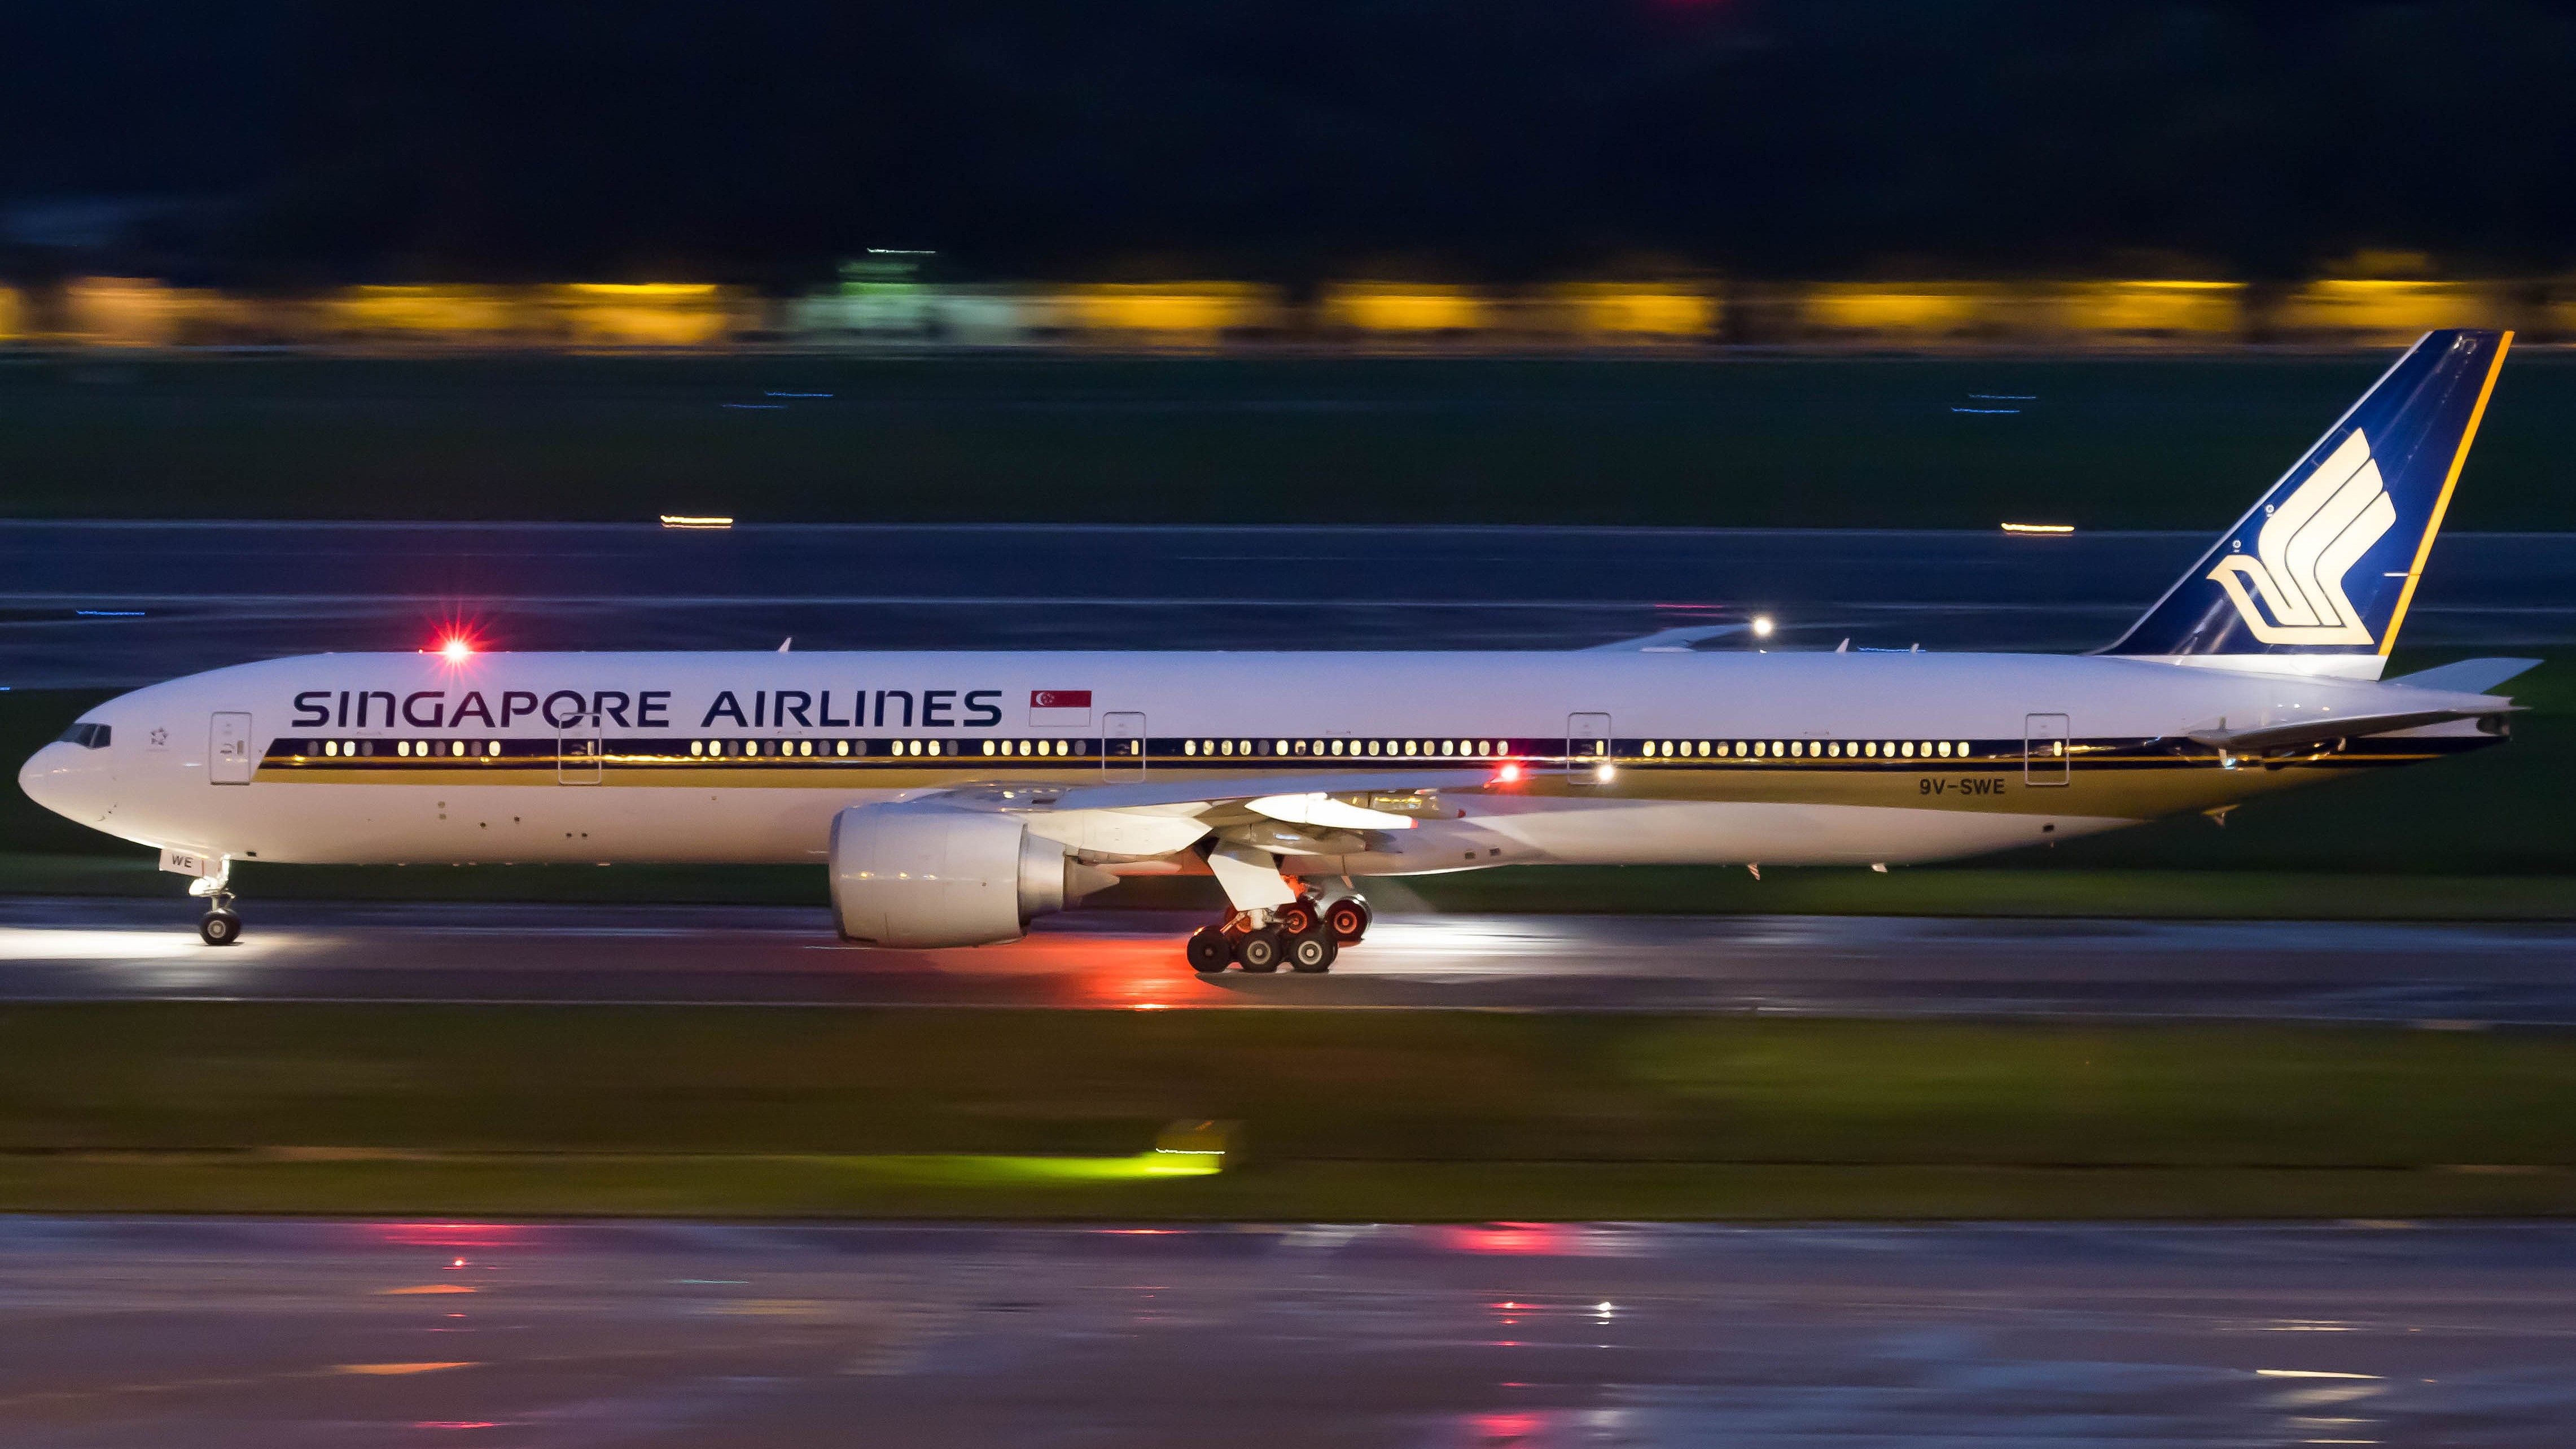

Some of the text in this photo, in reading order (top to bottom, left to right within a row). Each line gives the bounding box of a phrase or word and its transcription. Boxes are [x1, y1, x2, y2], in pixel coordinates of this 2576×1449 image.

[291, 689, 1003, 729] SINGAPORE AIRLINES
[1919, 778, 2007, 795] 9V-SWE
[172, 853, 193, 868] WE
